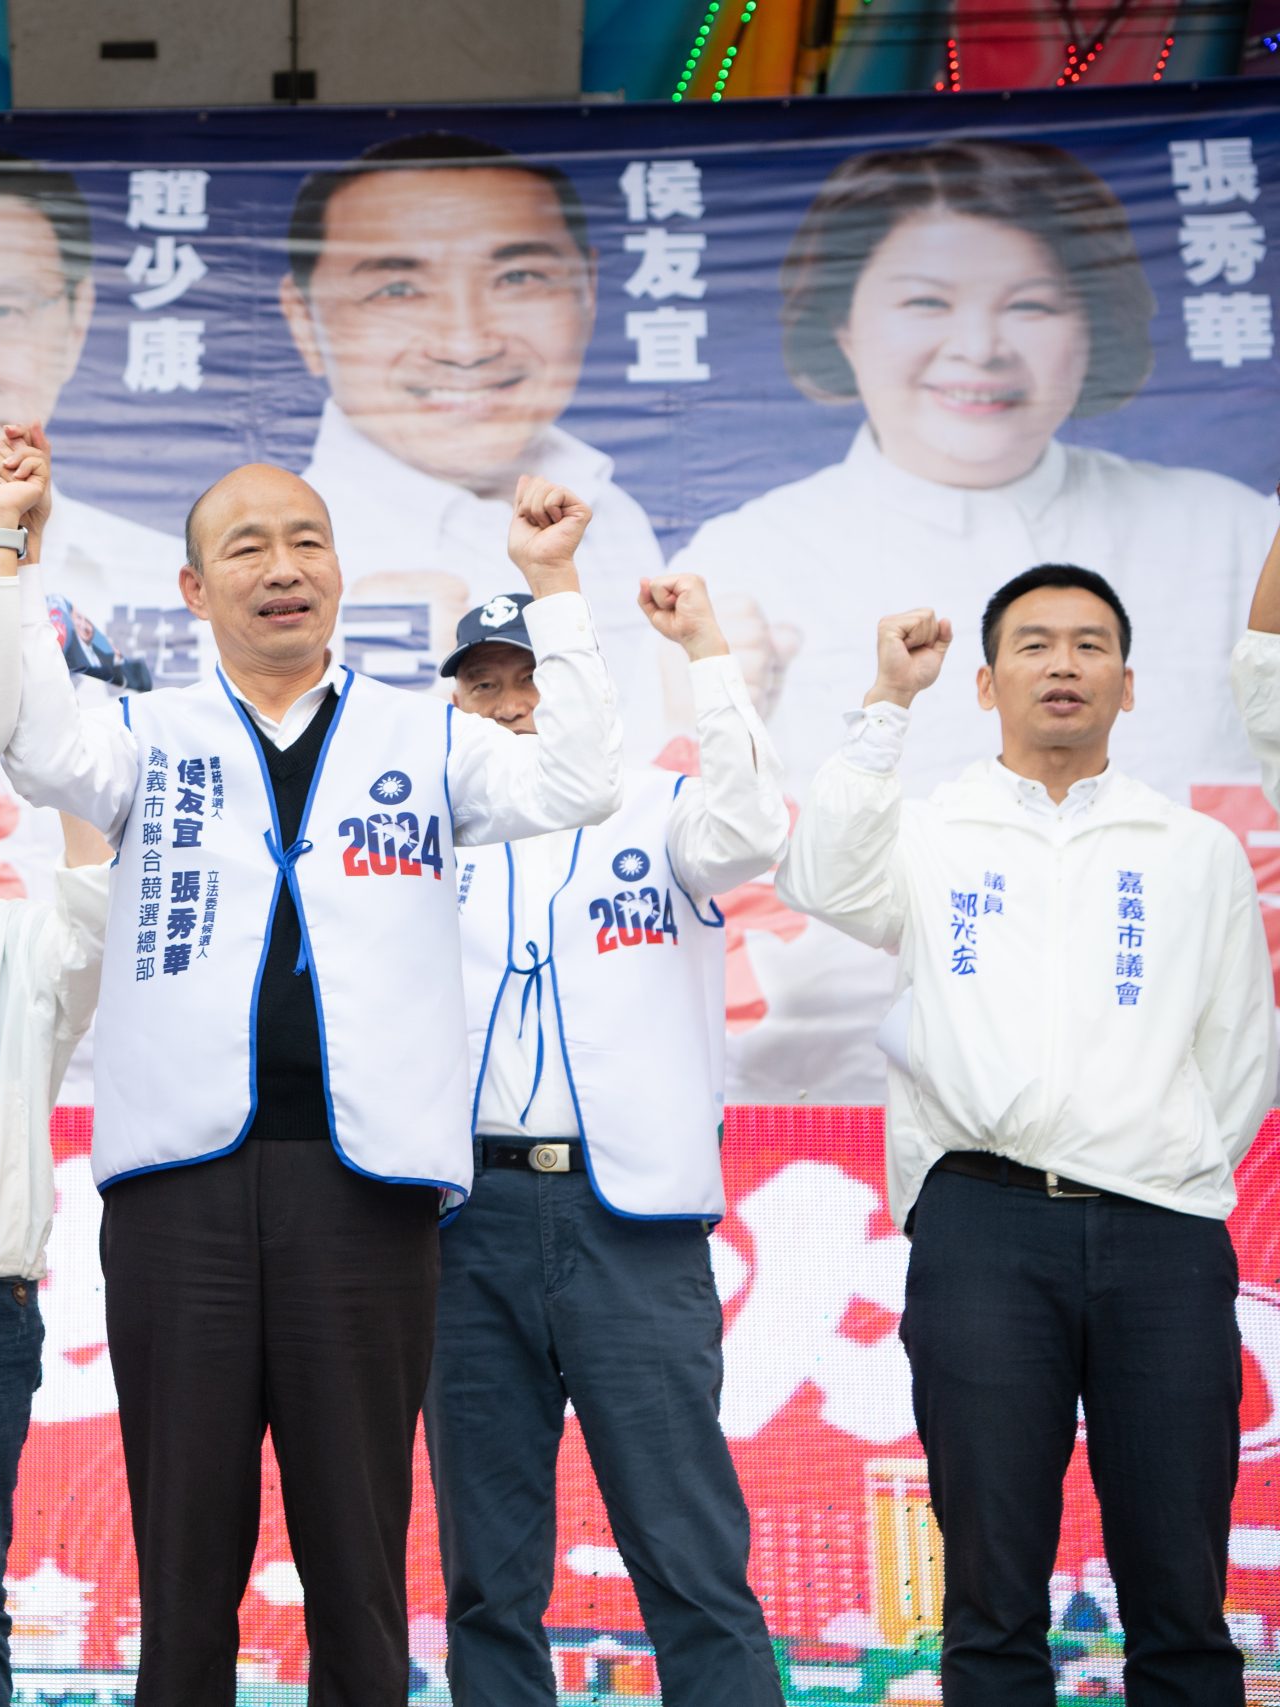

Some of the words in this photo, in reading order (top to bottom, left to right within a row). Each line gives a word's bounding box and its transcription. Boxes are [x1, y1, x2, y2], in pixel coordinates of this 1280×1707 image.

[123, 168, 209, 393] 趙少康
[619, 160, 711, 384] 侯友宜
[1166, 137, 1275, 369] 張秀華
[172, 758, 206, 849] 侯友宜
[209, 756, 224, 821] 總統候選人
[135, 745, 169, 982] 嘉義市聯合競選總部
[338, 811, 443, 881] 2024
[983, 870, 1006, 916] 議員
[163, 870, 201, 976] 張秀華
[196, 869, 220, 960] 立法委員候選人
[588, 886, 679, 955] 2024
[1114, 870, 1146, 1006] 嘉義市議會
